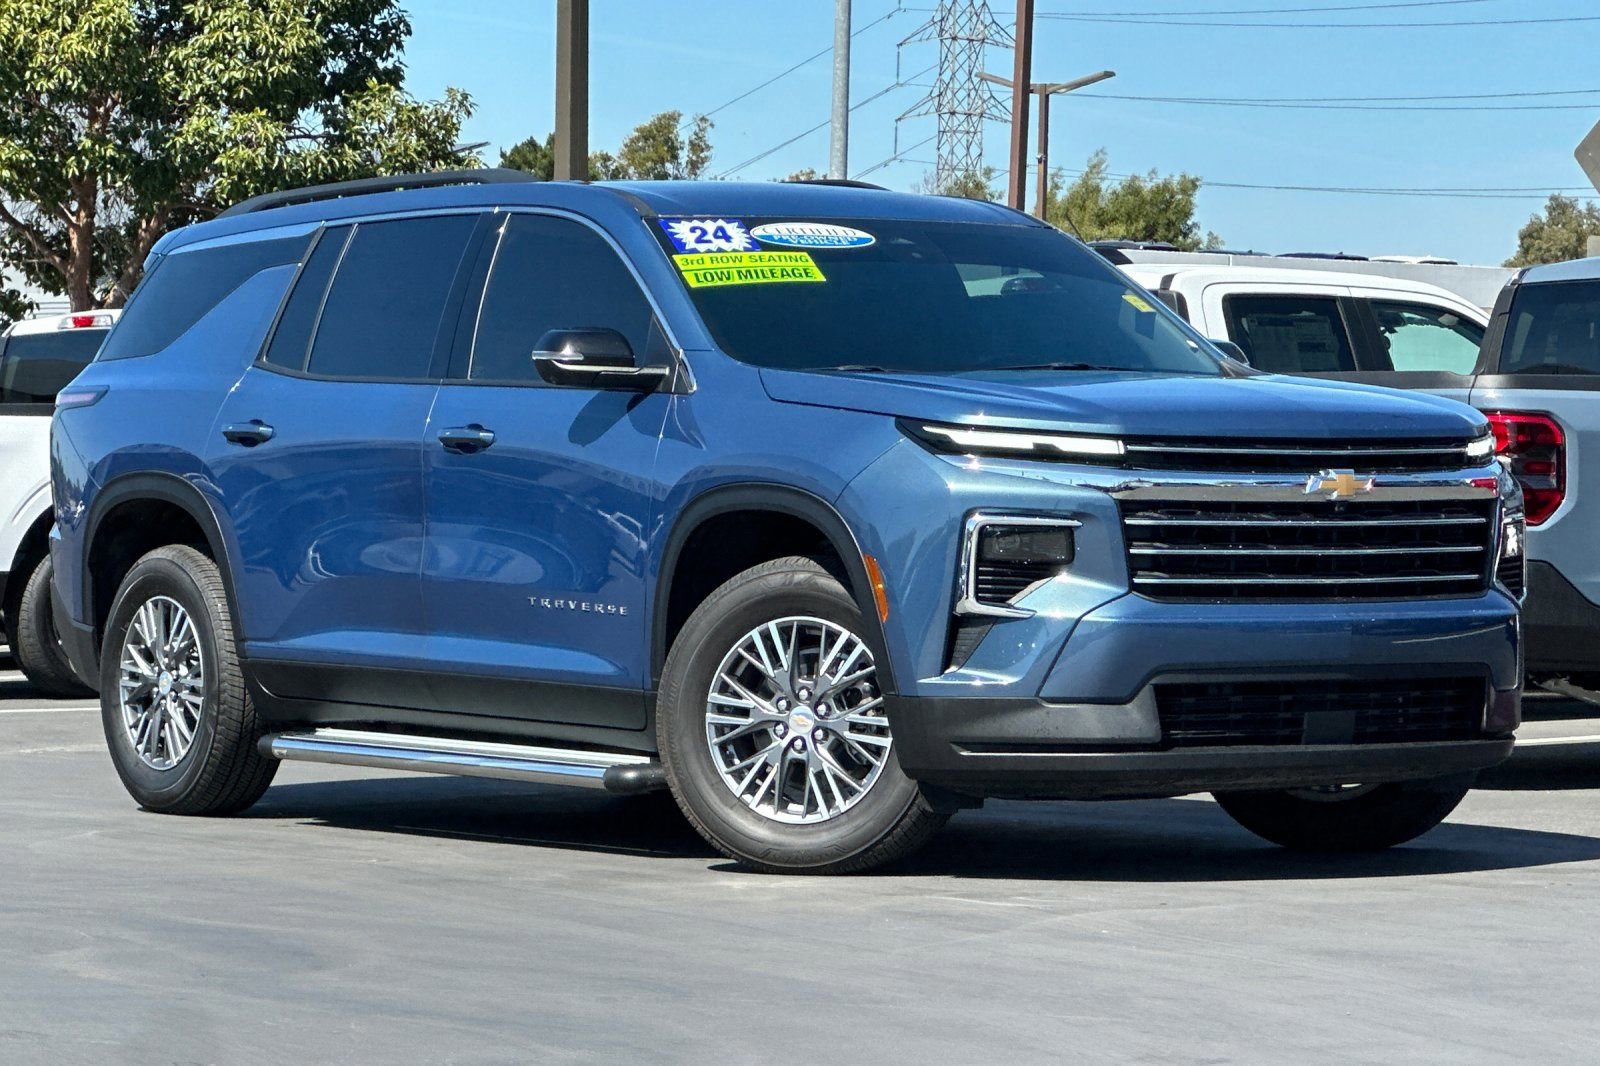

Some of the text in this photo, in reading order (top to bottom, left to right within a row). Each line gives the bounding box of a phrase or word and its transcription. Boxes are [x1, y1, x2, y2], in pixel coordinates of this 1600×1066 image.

[689, 225, 732, 244] 24
[681, 254, 809, 267] 3rd ROW SEATING
[694, 267, 814, 284] LOW MILEAGE
[528, 597, 628, 616] TRAVERSE
